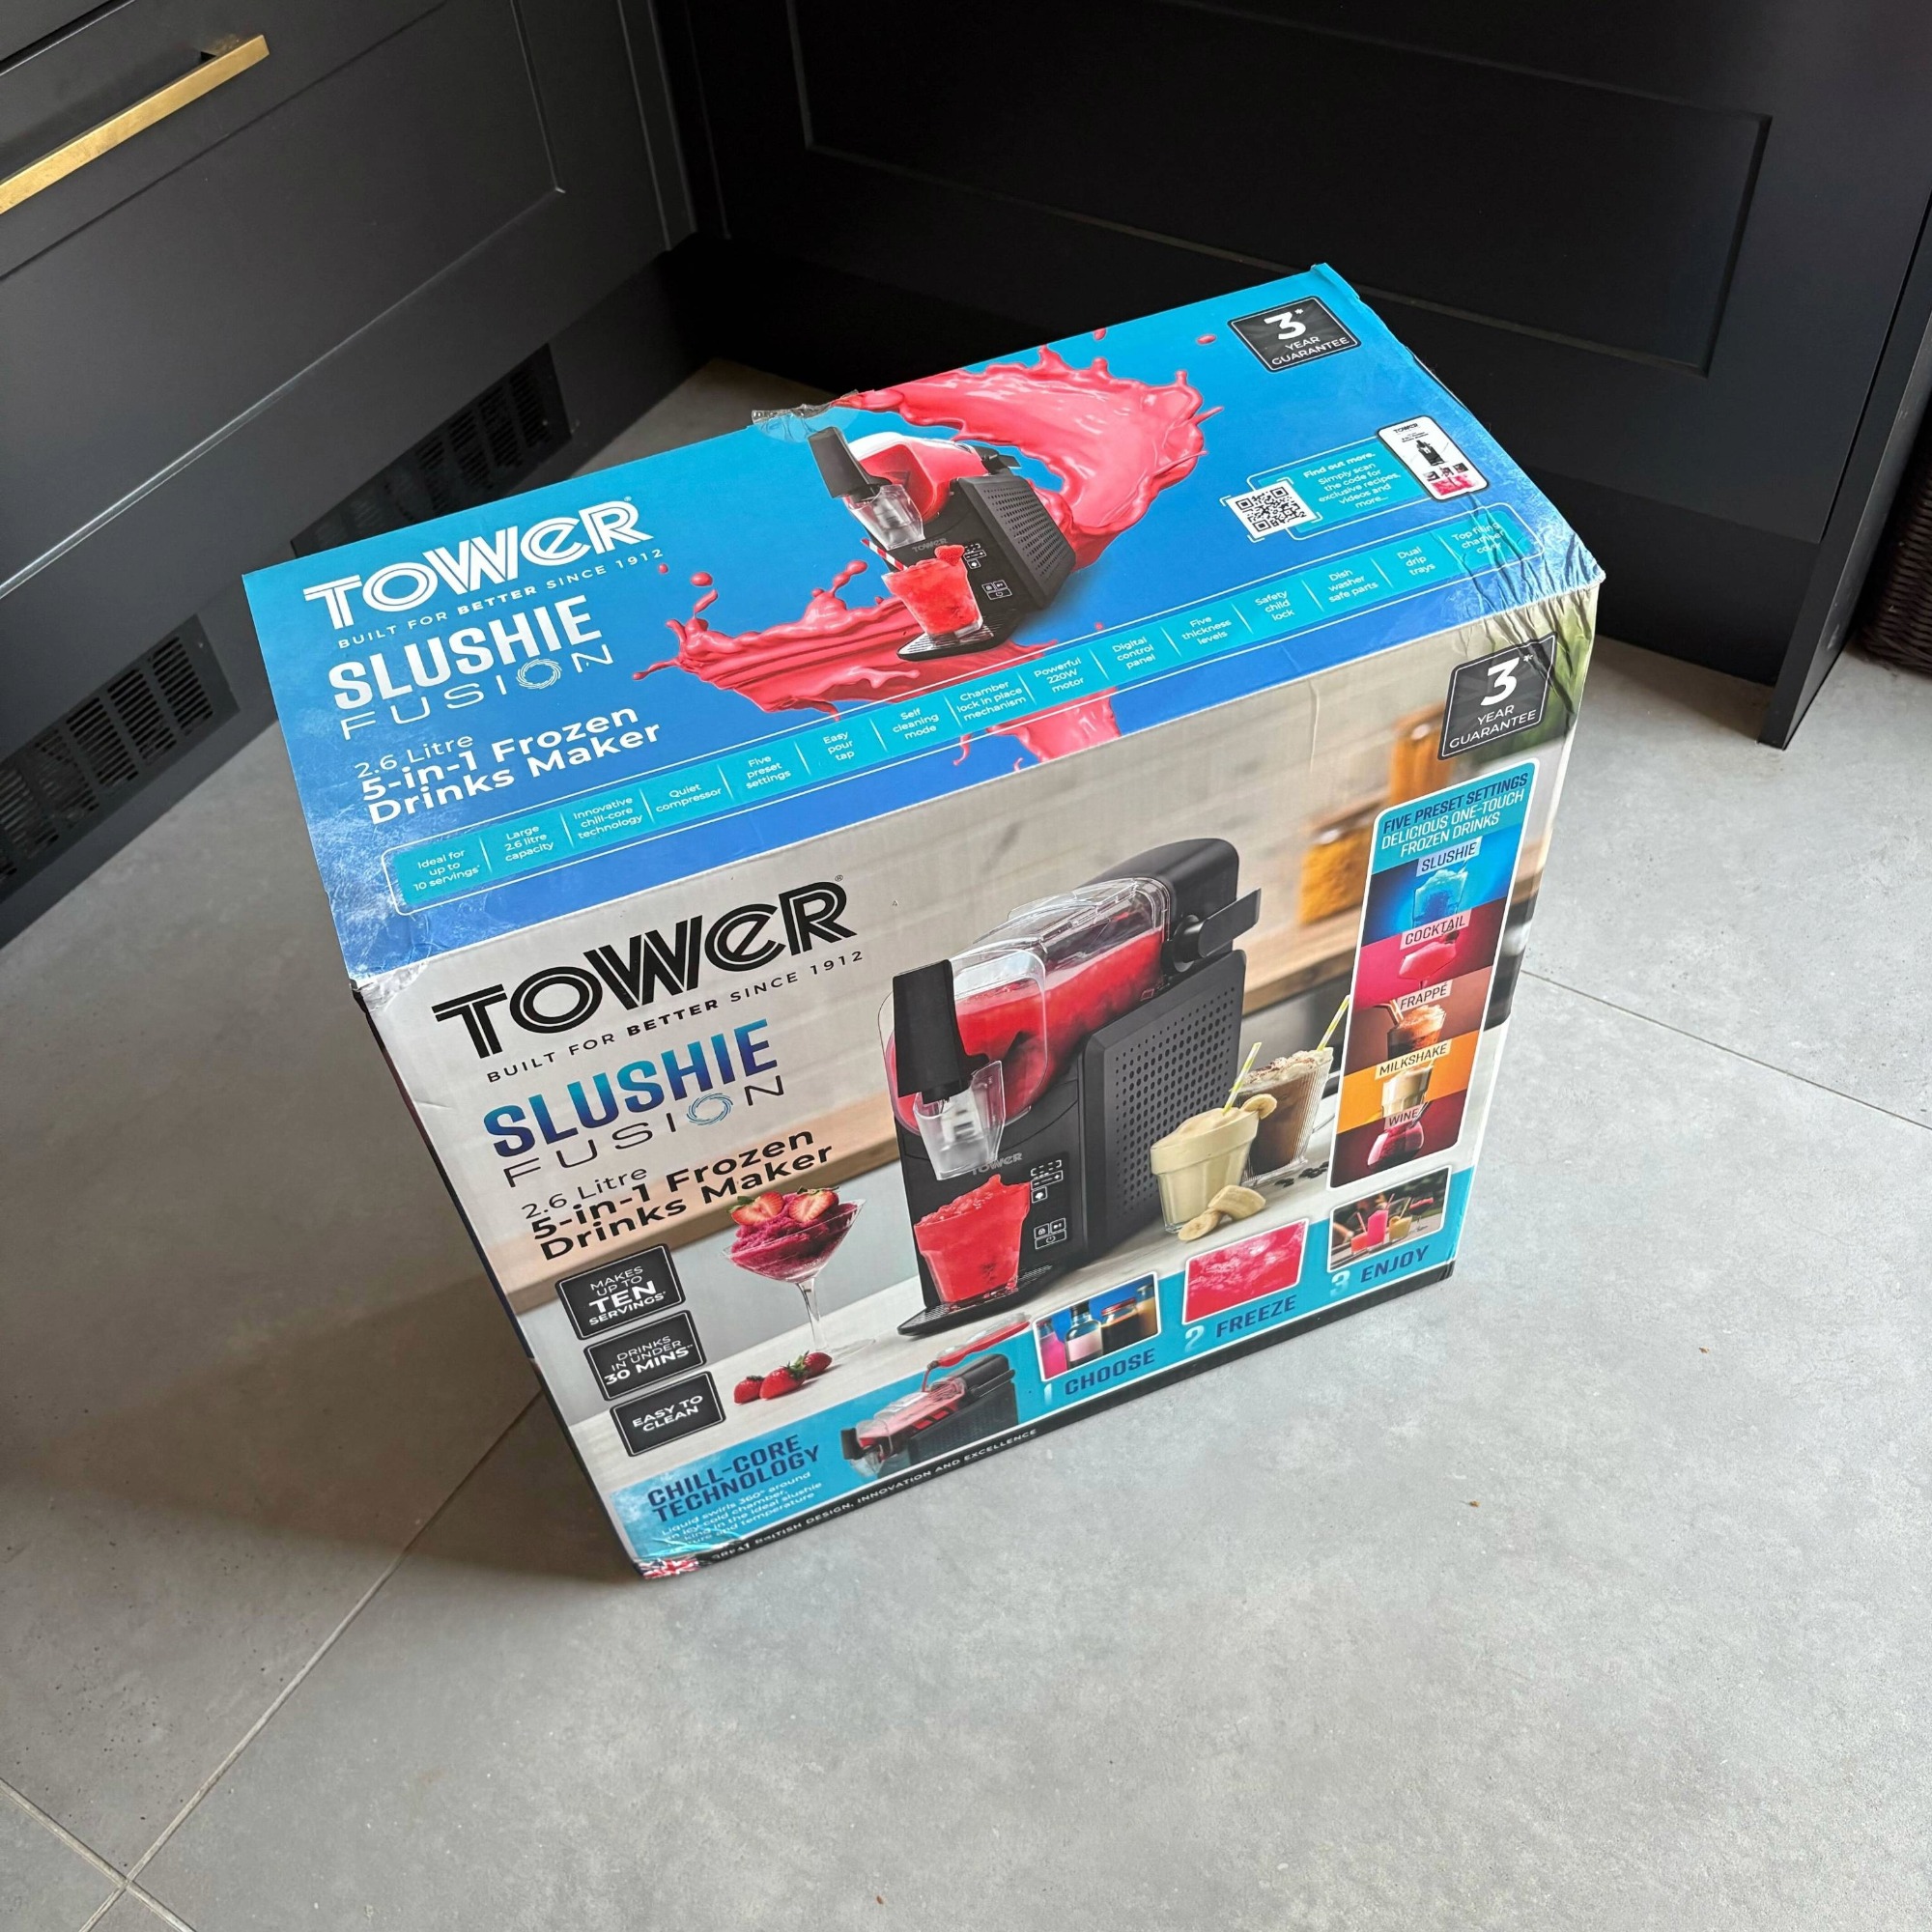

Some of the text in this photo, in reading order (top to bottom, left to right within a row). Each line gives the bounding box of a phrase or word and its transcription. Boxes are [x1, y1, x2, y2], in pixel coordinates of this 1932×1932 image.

[1272, 337, 1350, 366] GUARANTEE
[1285, 336, 1320, 352] YEAR
[1303, 467, 1326, 478] Find
[1328, 461, 1346, 469] out
[1319, 463, 1376, 484] Simply scan
[1344, 474, 1367, 485] code
[1319, 485, 1362, 502] exclusive
[1339, 483, 1391, 504] videos and
[1452, 531, 1472, 541] Top
[1397, 547, 1422, 558] Dual
[1406, 556, 1427, 566] drip
[1328, 569, 1352, 582] Dish
[1409, 564, 1435, 575] trays
[1328, 576, 1365, 592] washer
[1328, 582, 1378, 603] safe parts
[338, 549, 664, 648] BUILT FOR BETTER SINCE 1912
[1255, 590, 1288, 606] Safety
[1265, 599, 1291, 612] child
[1190, 616, 1211, 627] Five
[1272, 609, 1294, 621] lock
[1181, 619, 1232, 640] thickness
[1197, 631, 1228, 645] levels
[328, 596, 602, 710] SLUSHIE
[1112, 637, 1147, 653] Digital
[1117, 644, 1153, 662] control
[1034, 657, 1082, 678] Powerful
[1125, 654, 1155, 669] panel
[1047, 668, 1077, 684] 220W
[1052, 676, 1085, 694] motor
[340, 644, 614, 740] FUSION
[956, 687, 1023, 713] lock in place
[960, 681, 1009, 701] Chamber
[900, 707, 922, 721] Self
[964, 696, 1026, 722] mechanism
[1477, 705, 1515, 724] YEAR
[893, 713, 940, 733] cleaning
[904, 724, 936, 740] mode
[1450, 710, 1536, 748] GUARANTEE
[823, 731, 848, 745] Easy
[827, 740, 853, 754] pour
[355, 734, 473, 779] 2.6 Litre
[362, 707, 639, 801] 5-in-1 Frozen
[748, 754, 772, 768] Five
[836, 750, 855, 761] tap
[368, 724, 661, 824] Drinks Maker
[746, 770, 791, 789] settings
[747, 762, 782, 780] preset
[656, 786, 722, 812] compressor
[668, 783, 701, 799] Quiet
[573, 797, 633, 819] Innovative
[1383, 773, 1528, 834] FIVE PRESET SETTINGS
[578, 814, 642, 839] technology
[581, 807, 633, 828] chill-core
[1382, 789, 1524, 849] DELICIOUS ONE-TOUCH
[505, 833, 547, 851] 2.6 litre
[506, 826, 540, 840] Large
[1401, 812, 1500, 857] FROZEN DRINKS
[417, 849, 465, 869] Ideal for
[505, 841, 554, 862] capacity
[1421, 840, 1477, 871] SLUSHIE
[429, 862, 461, 877] up to
[413, 882, 427, 891] 10
[1405, 916, 1465, 945] COCKTAIL
[1400, 982, 1448, 1009] FRAPPÉ
[487, 951, 863, 1082] BUILT FOR BETTER SINCE 1912
[1378, 1042, 1447, 1076] MILKSHAKE
[483, 1019, 778, 1157] SLUSHIE
[1389, 1108, 1418, 1125] WINE
[503, 1075, 784, 1187] FUSION
[522, 1167, 647, 1219] 2.6 Litre
[531, 1130, 814, 1240] 5-in-1 Frozen
[540, 1144, 833, 1261] Drinks Maker
[590, 1265, 642, 1291] MAKES
[1330, 1244, 1430, 1299] 3 ENJOY
[597, 1276, 642, 1295] UP TO
[589, 1280, 657, 1313] TEN
[1185, 1294, 1295, 1352] 2 FREEZE
[611, 1340, 682, 1371] IN UNDER
[617, 1336, 671, 1361] DRINKS
[604, 1370, 631, 1385] 30
[1044, 1349, 1155, 1405] 1 CHOOSE
[633, 1395, 703, 1427] EASY TO
[642, 1406, 698, 1432] CLEAN
[648, 1435, 802, 1507] CHILL-CORE
[652, 1445, 819, 1522] TECHNOLOGY
[755, 1522, 802, 1544] BRITISH
[857, 1470, 931, 1503] INNOVATION
[935, 1459, 960, 1472] AND
[964, 1429, 1037, 1461] EXCELLENCE
[662, 1517, 699, 1535] Liquid
[702, 1503, 736, 1519] swirls
[769, 1471, 810, 1492] around
[714, 1520, 725, 1529] in
[728, 1512, 748, 1524] the
[751, 1501, 780, 1515] ideal
[782, 1482, 822, 1501] slushie
[741, 1492, 814, 1526] temperature
